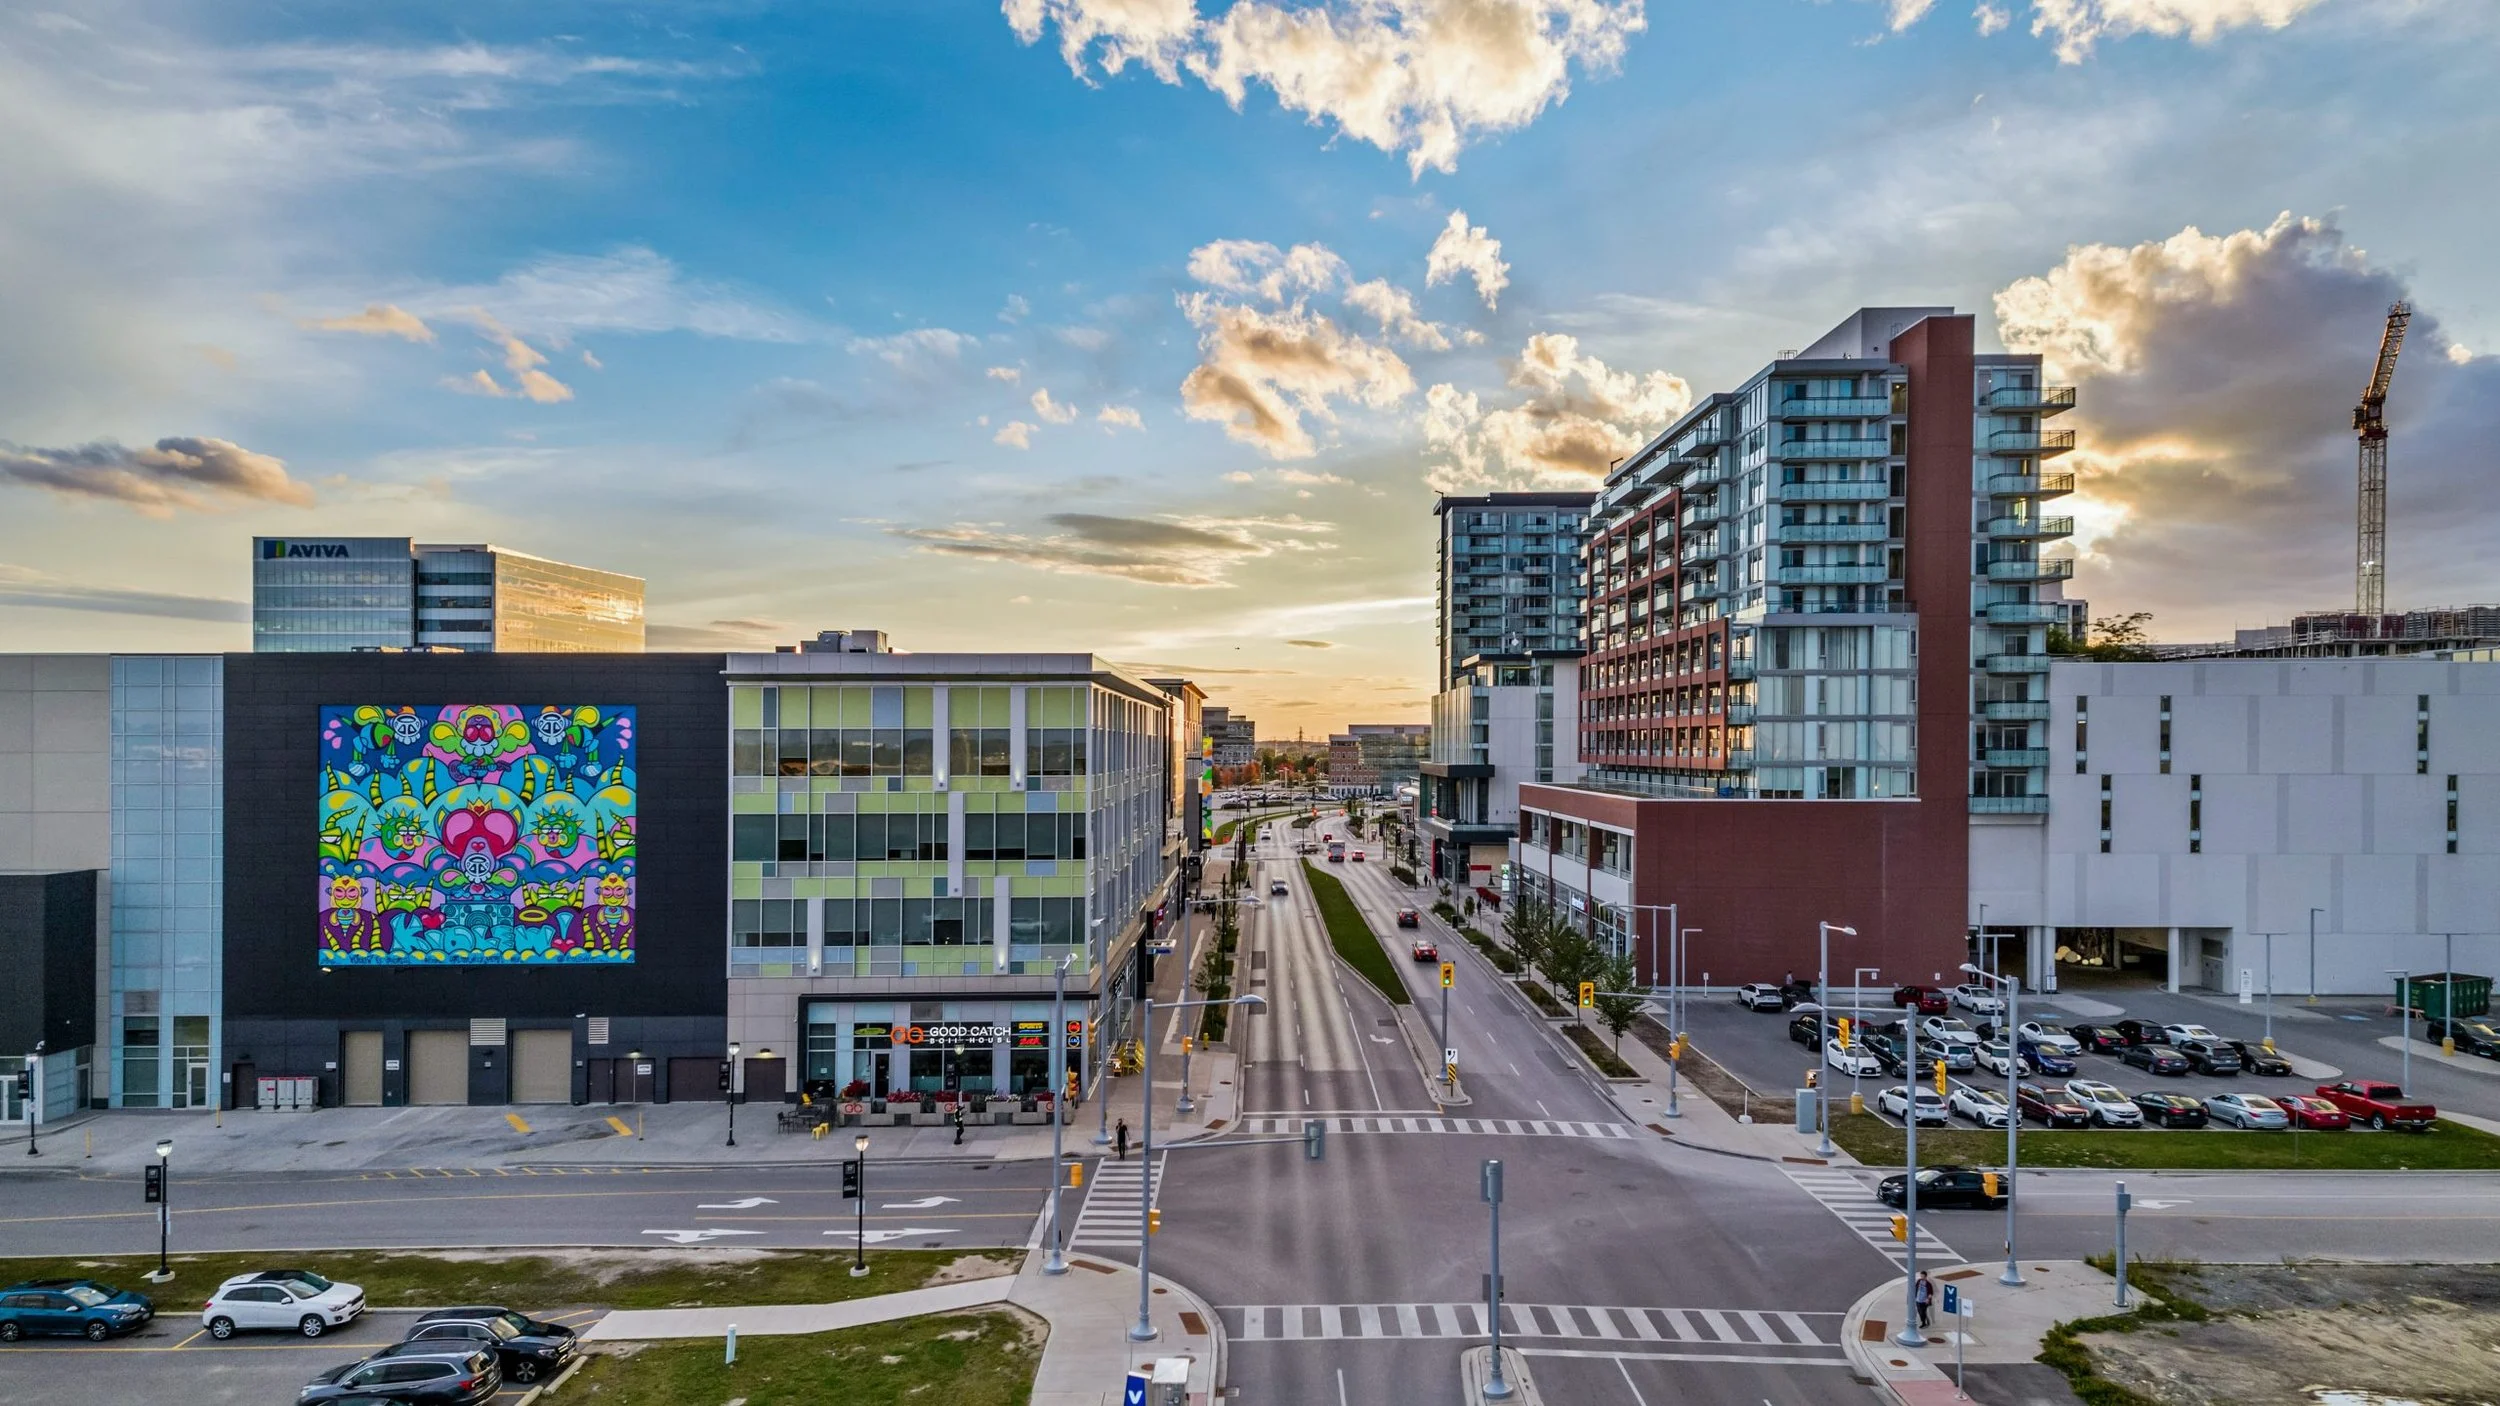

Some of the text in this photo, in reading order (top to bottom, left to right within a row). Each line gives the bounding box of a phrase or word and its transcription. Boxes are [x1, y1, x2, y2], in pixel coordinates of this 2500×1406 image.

[288, 544, 349, 558] AVIVA
[929, 1026, 1011, 1037] GOOD CATCH
